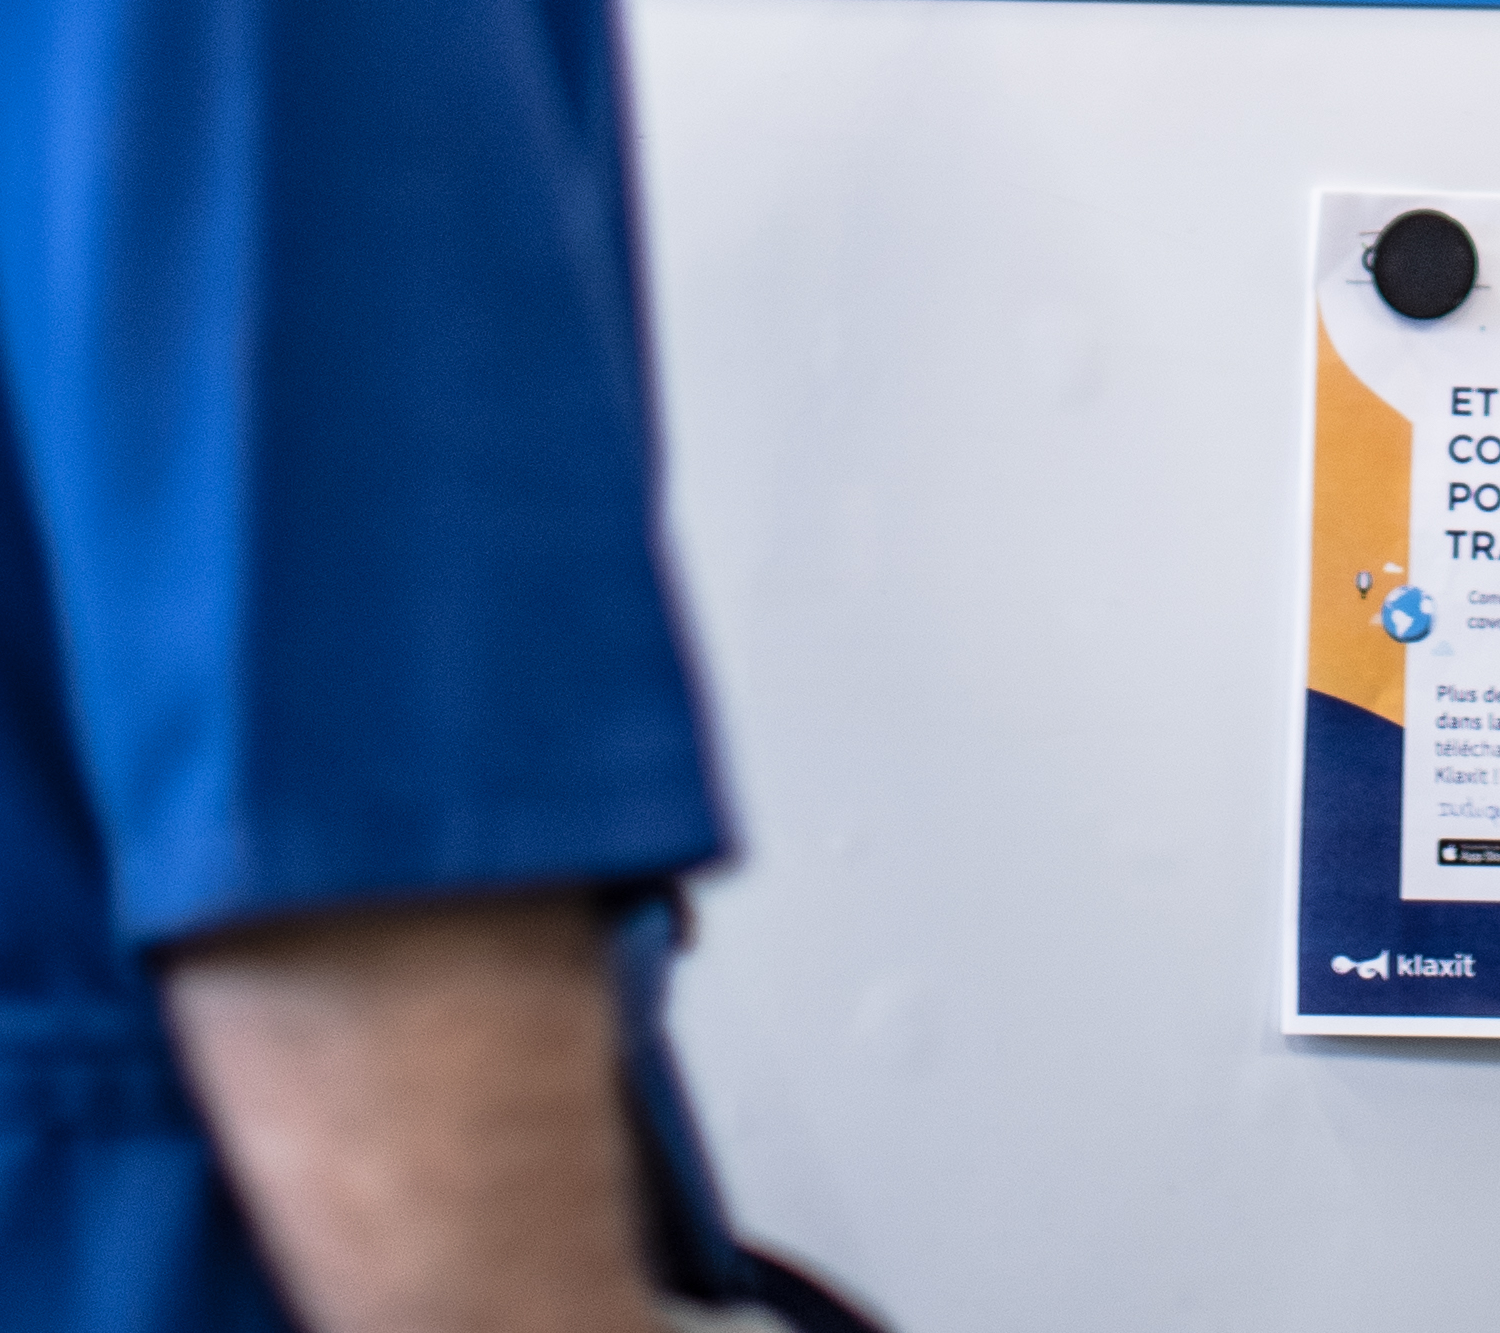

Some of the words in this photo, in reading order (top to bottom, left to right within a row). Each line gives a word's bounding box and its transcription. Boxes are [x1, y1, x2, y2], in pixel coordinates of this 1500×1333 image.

[1451, 387, 1498, 418] ET
[1437, 685, 1477, 702] Plus
[1436, 712, 1482, 730] dans
[1435, 767, 1487, 784] Klaxit
[1398, 952, 1477, 979] klaxit
